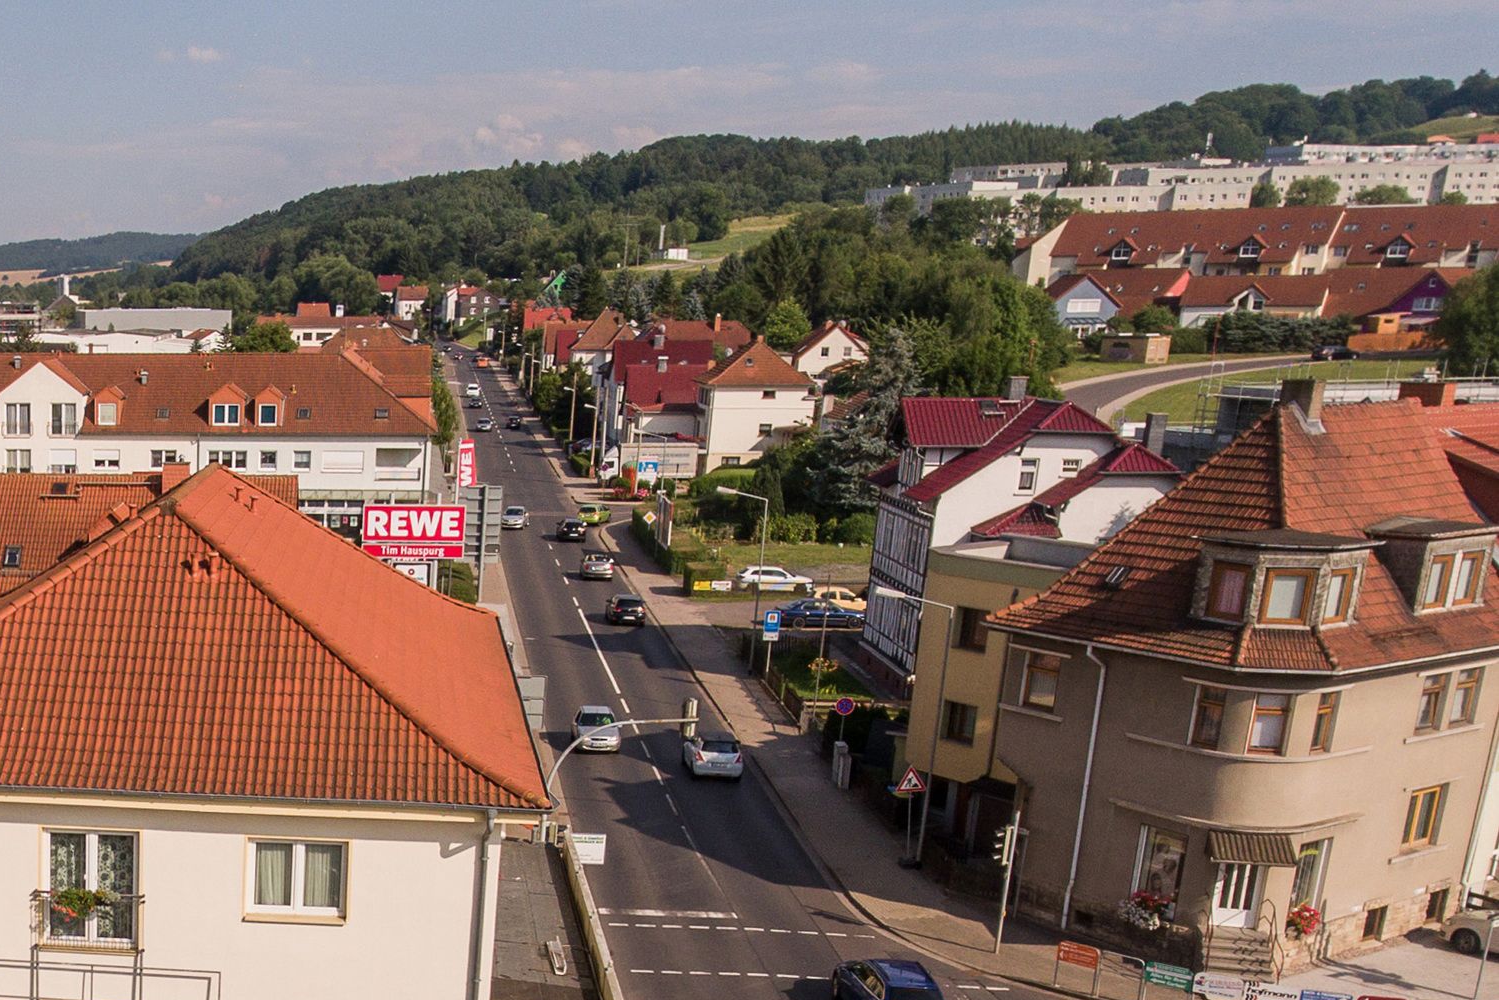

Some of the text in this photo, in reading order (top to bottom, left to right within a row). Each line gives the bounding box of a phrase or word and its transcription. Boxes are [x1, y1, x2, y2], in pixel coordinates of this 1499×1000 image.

[460, 451, 472, 487] WE
[367, 510, 460, 537] REWE
[381, 545, 445, 557] Tim Hauspurg
[1247, 987, 1298, 999] hofmann
